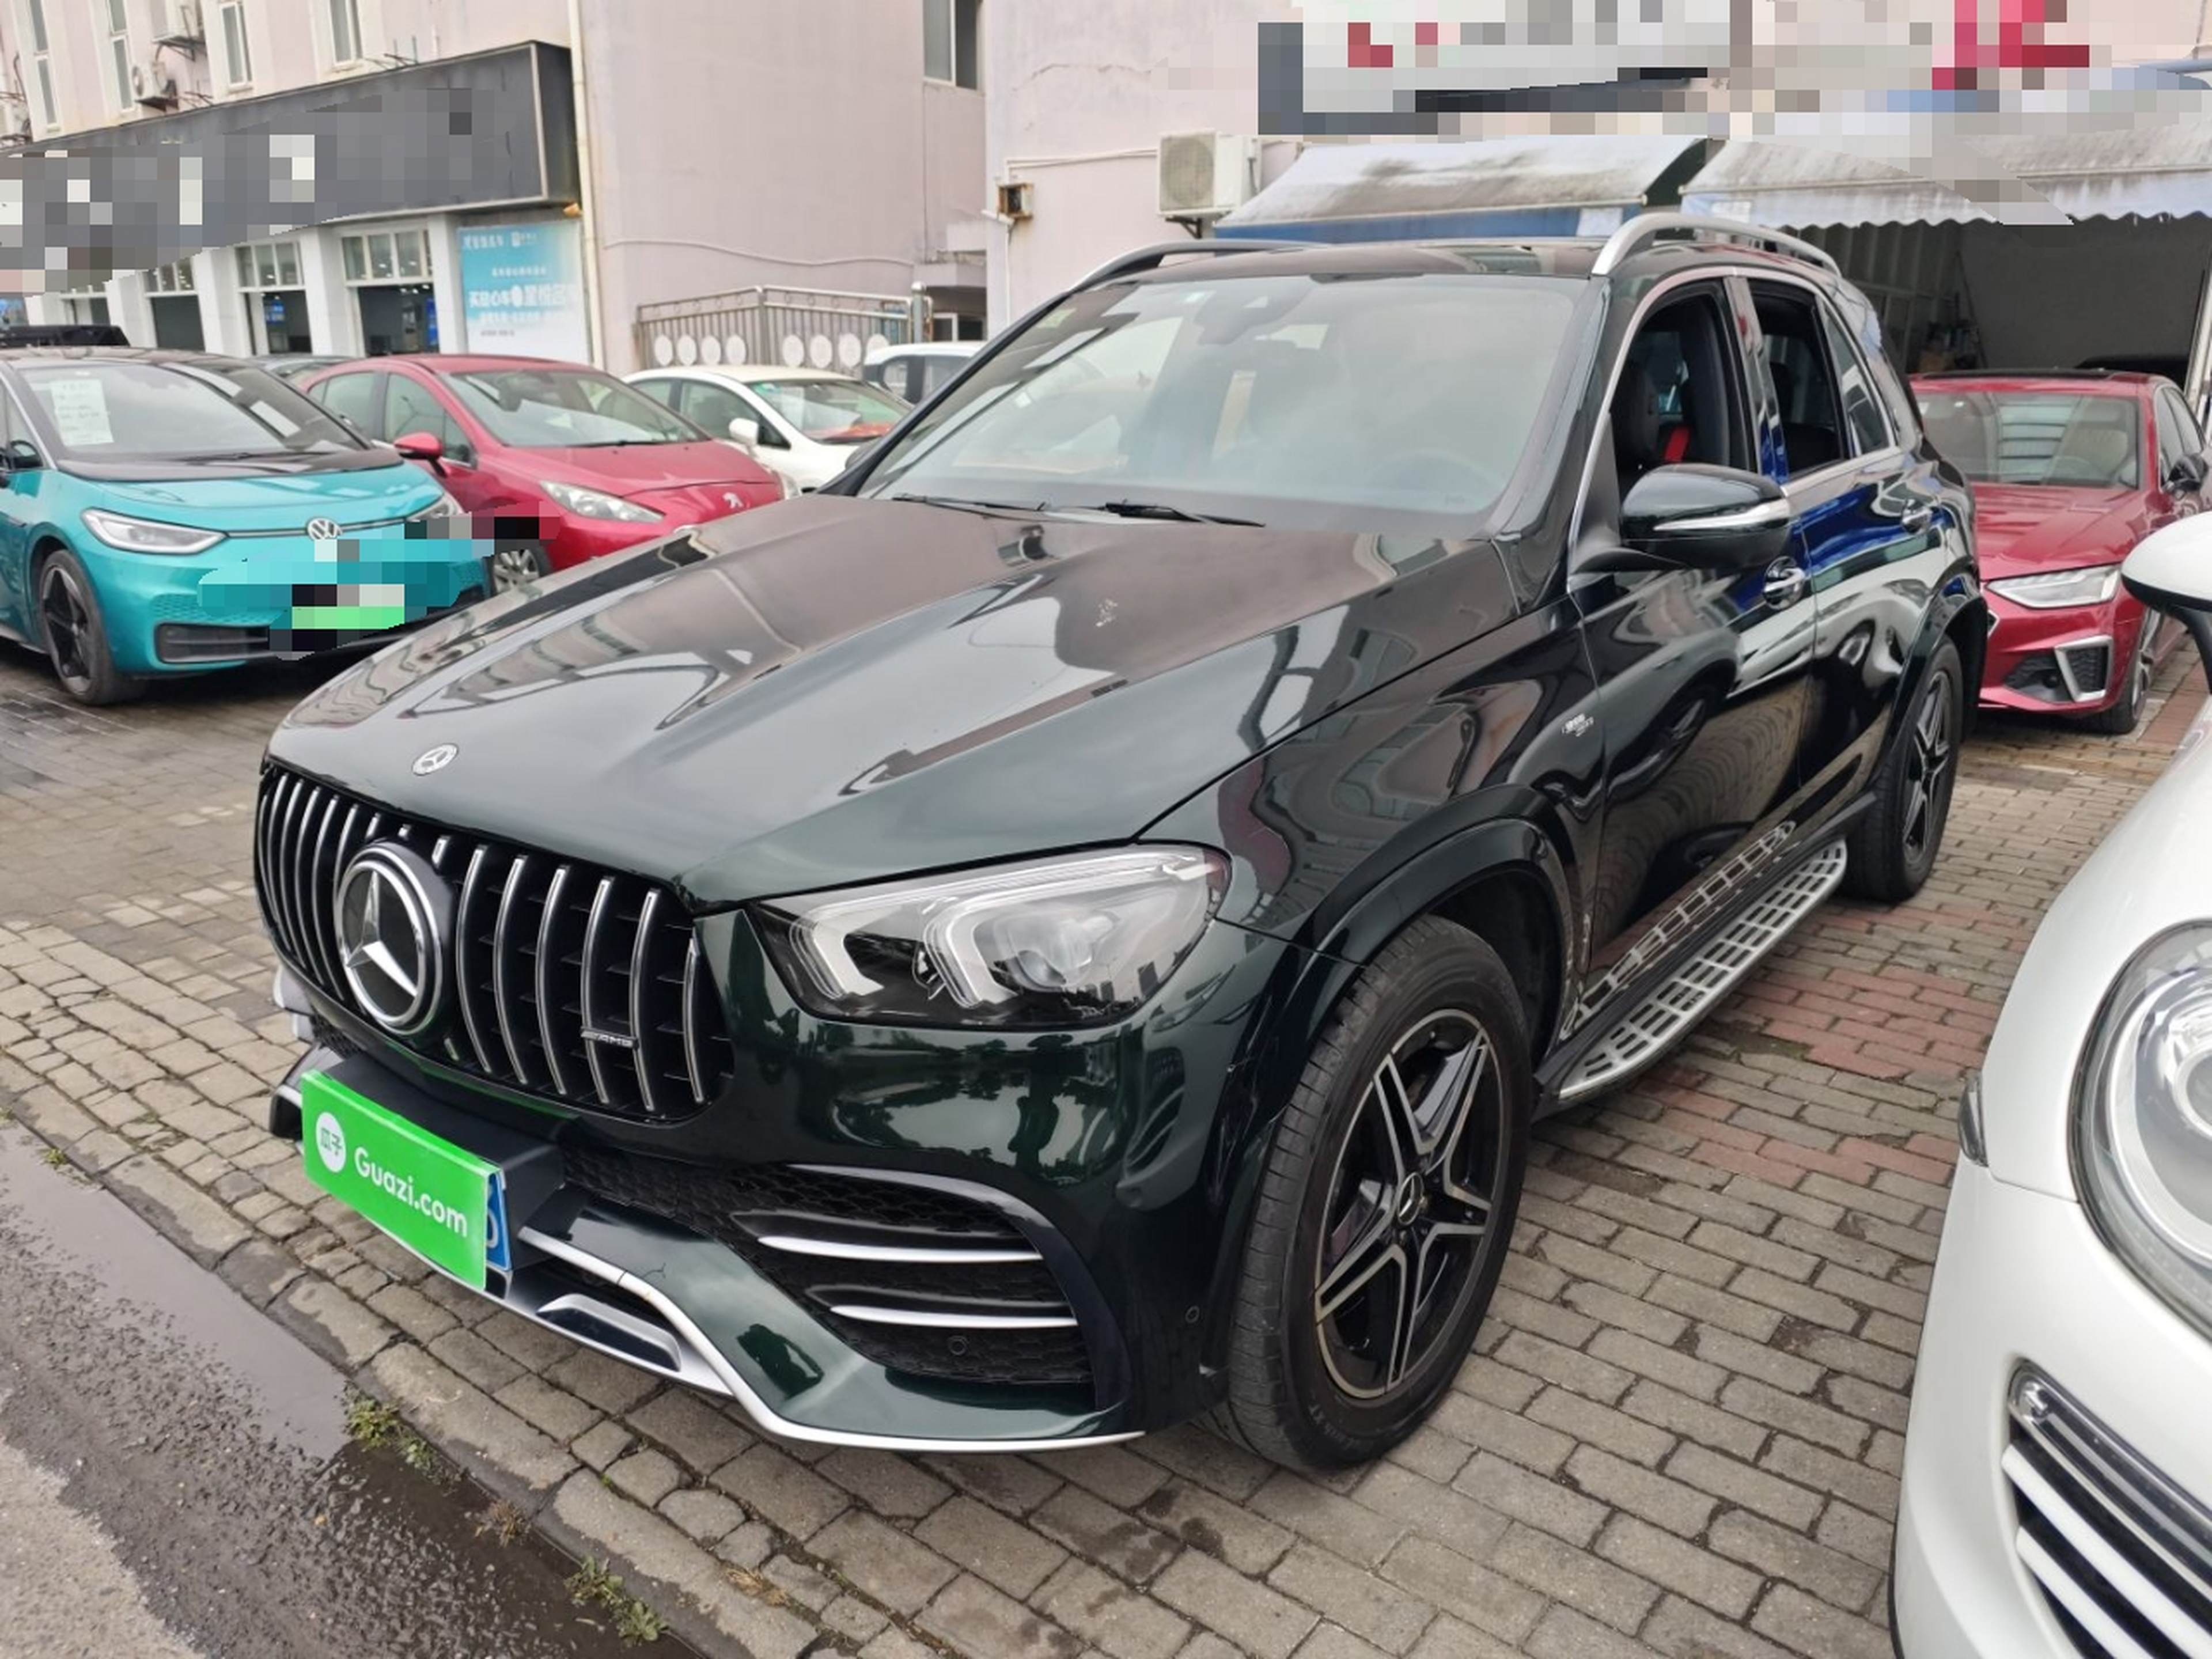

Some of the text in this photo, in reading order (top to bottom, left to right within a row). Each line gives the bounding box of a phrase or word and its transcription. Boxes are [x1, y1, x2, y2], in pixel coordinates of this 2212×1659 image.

[597, 1034, 633, 1048] AMG
[320, 1127, 343, 1156] 瓜子
[354, 1146, 468, 1238] Guazi.com
